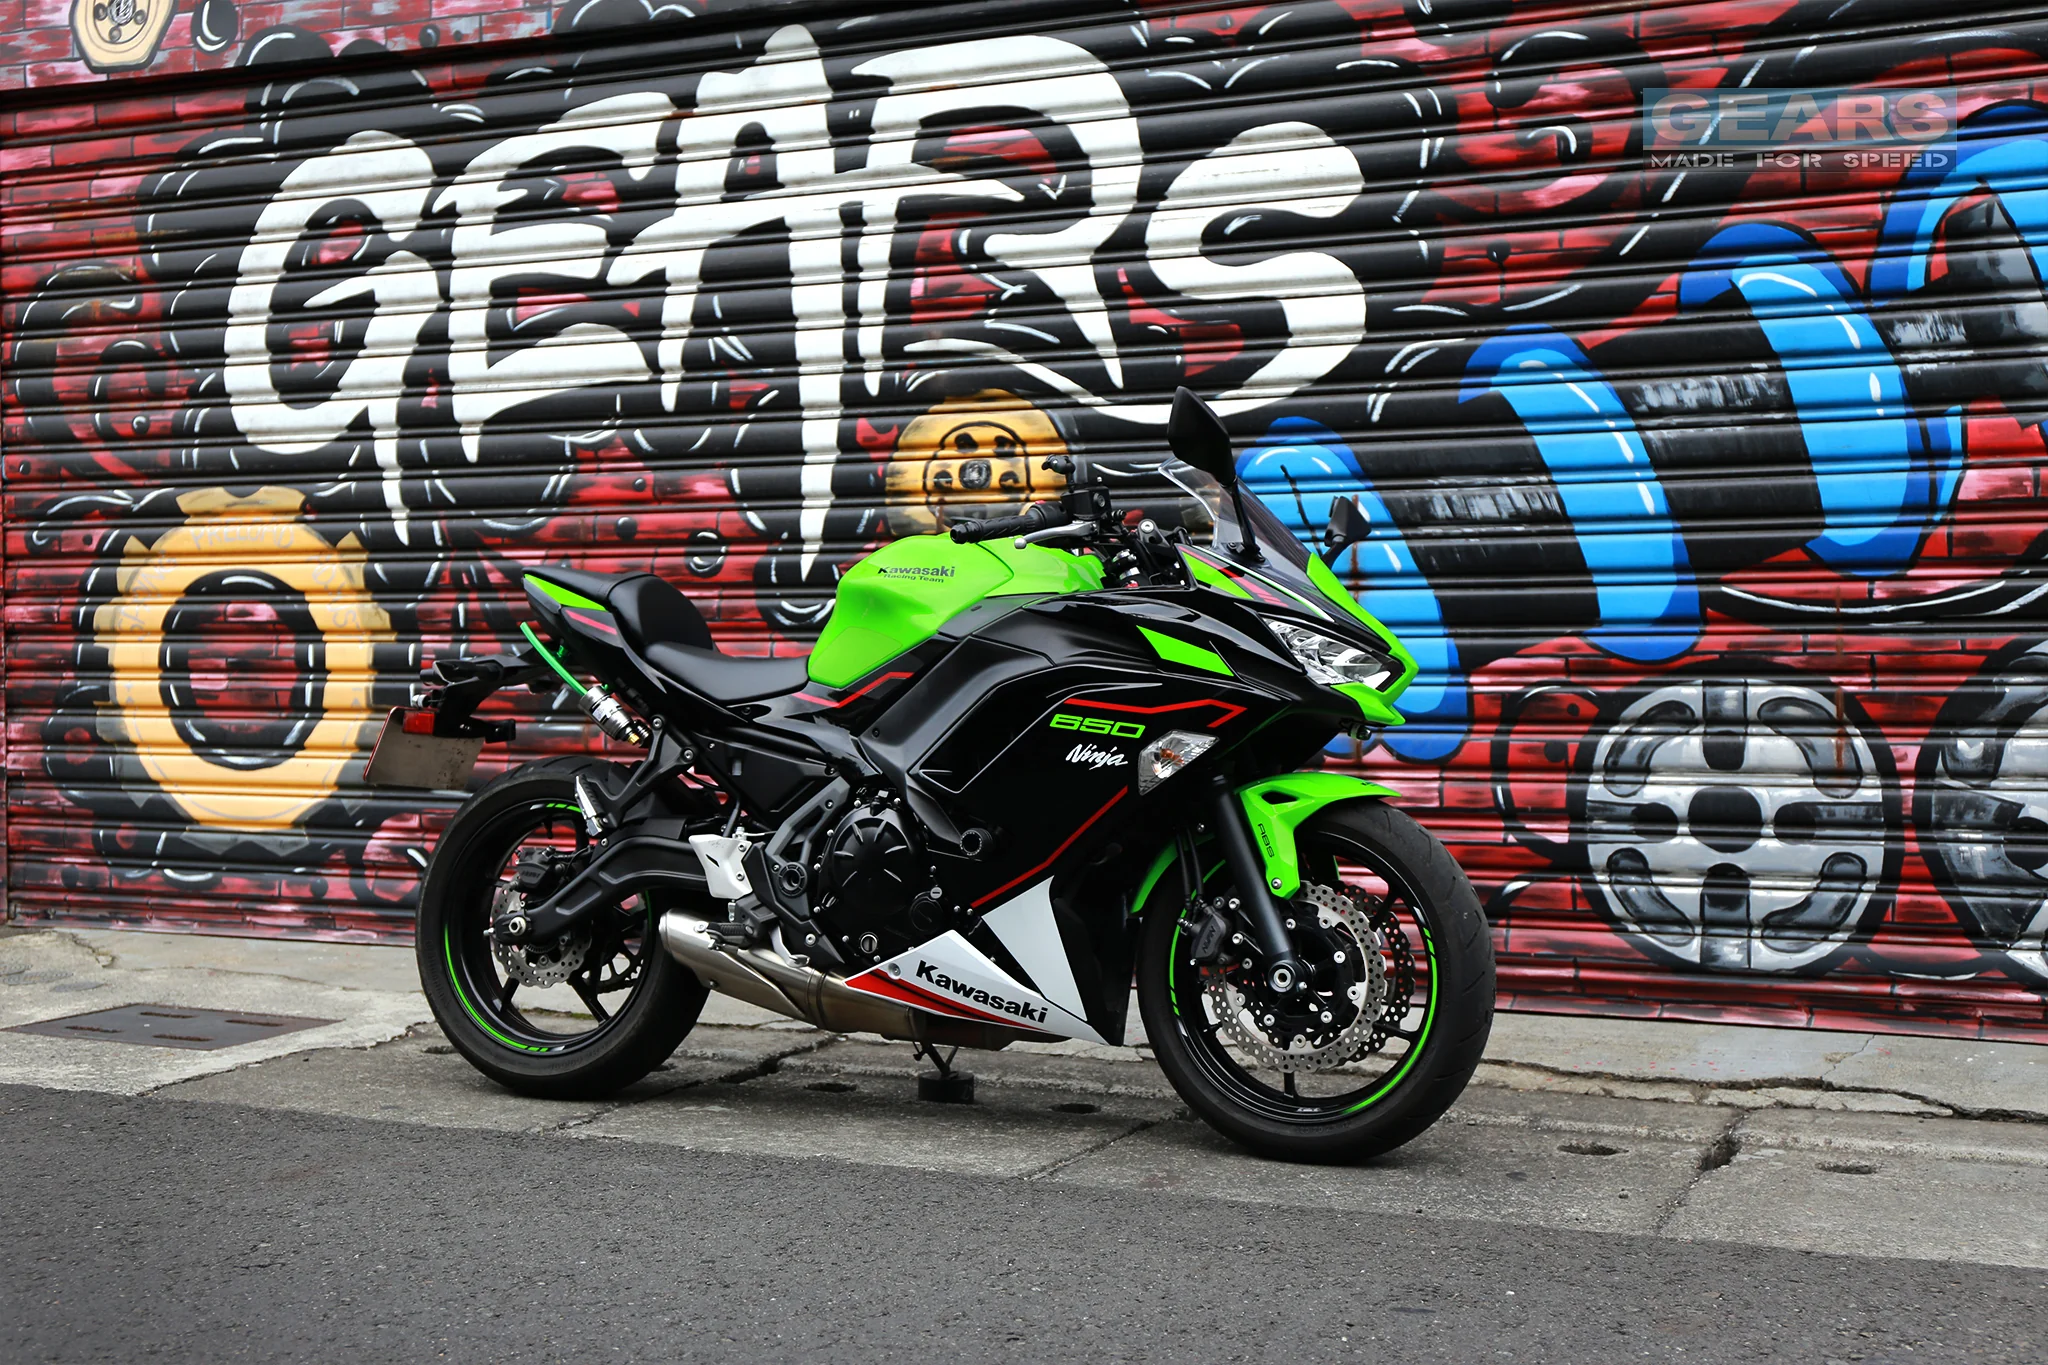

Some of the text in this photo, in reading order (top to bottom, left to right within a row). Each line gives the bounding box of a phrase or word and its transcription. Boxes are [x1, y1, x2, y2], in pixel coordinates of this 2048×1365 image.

[225, 24, 1367, 584] GEARS
[877, 565, 956, 578] Kawasaki
[919, 575, 945, 583] Team
[1049, 713, 1146, 739] 650
[1065, 743, 1129, 770] Ninja
[1257, 823, 1275, 858] ABS
[915, 960, 1049, 1024] Kawasaki
